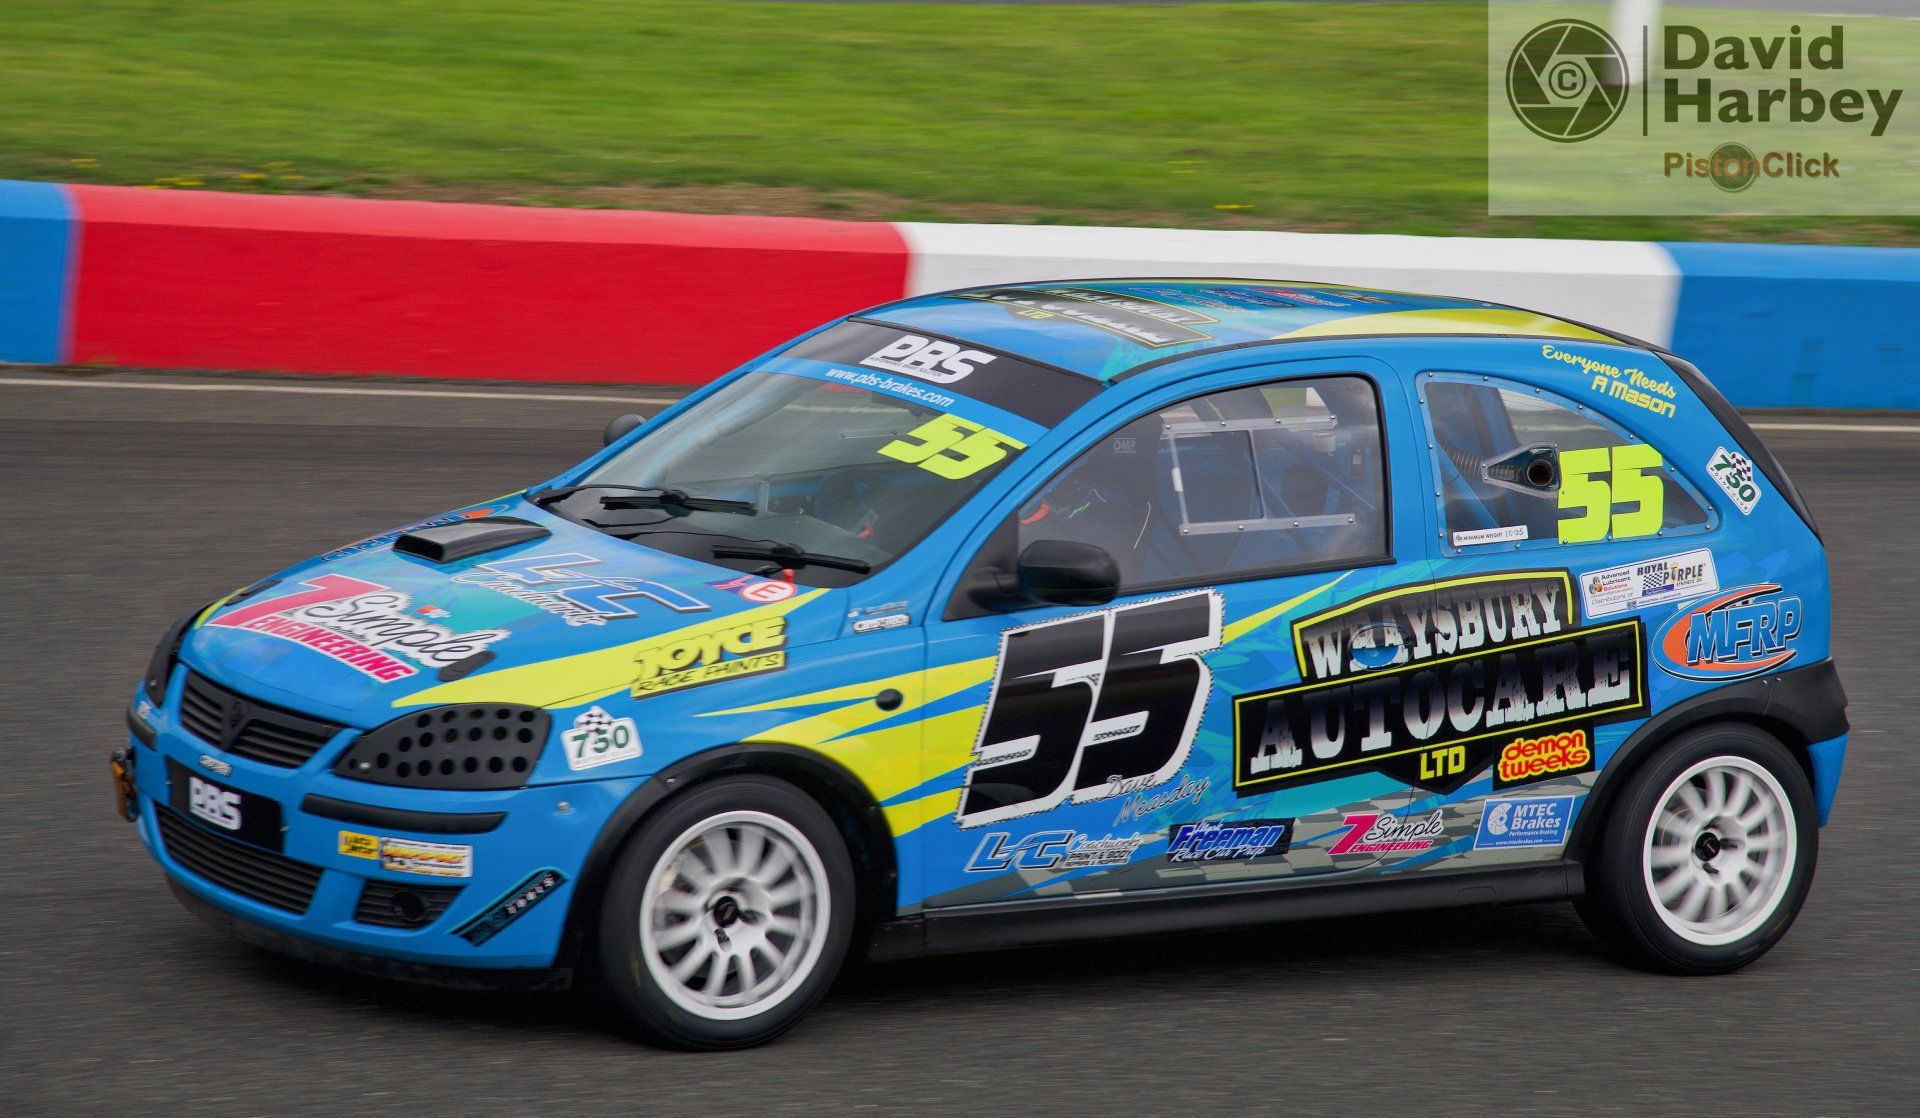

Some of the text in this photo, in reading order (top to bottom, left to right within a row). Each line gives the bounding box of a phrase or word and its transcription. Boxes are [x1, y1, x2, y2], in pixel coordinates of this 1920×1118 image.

[859, 335, 998, 384] PBS
[1542, 345, 1677, 399] Everyone Needs
[825, 368, 955, 408] www.pbs-brakes.com
[1592, 375, 1608, 393] A
[876, 413, 1029, 480] 55
[1113, 438, 1137, 452] OMP
[1558, 443, 1664, 545] 55
[1714, 454, 1756, 503] 750
[1601, 570, 1630, 580] Advanced
[1603, 576, 1631, 586] Lubricant
[1637, 562, 1668, 575] ROYAL
[303, 593, 500, 662] Simple
[1305, 580, 1563, 679] WRAYSBURY
[1686, 597, 1803, 665] MFRP
[245, 615, 417, 682] ENGINEERING
[632, 616, 787, 683] JOYCE
[638, 653, 781, 691] RACE PAINTS
[957, 588, 1224, 819] 55
[1250, 632, 1631, 775] AUTOCARE
[573, 726, 629, 758] 750
[1504, 731, 1585, 758] demon
[1420, 745, 1466, 780] LTD
[1499, 749, 1588, 780] tweeks
[189, 776, 242, 830] PBS
[1104, 774, 1157, 799] Dave
[1112, 776, 1211, 826] Measday
[1511, 816, 1562, 830] Brakes
[1513, 803, 1557, 817] MTEC
[1167, 825, 1286, 853] Freeman
[1328, 809, 1443, 855] 7 Simple
[1351, 840, 1434, 853] ENGINEERING
[1170, 844, 1267, 862] Race Car Prep
